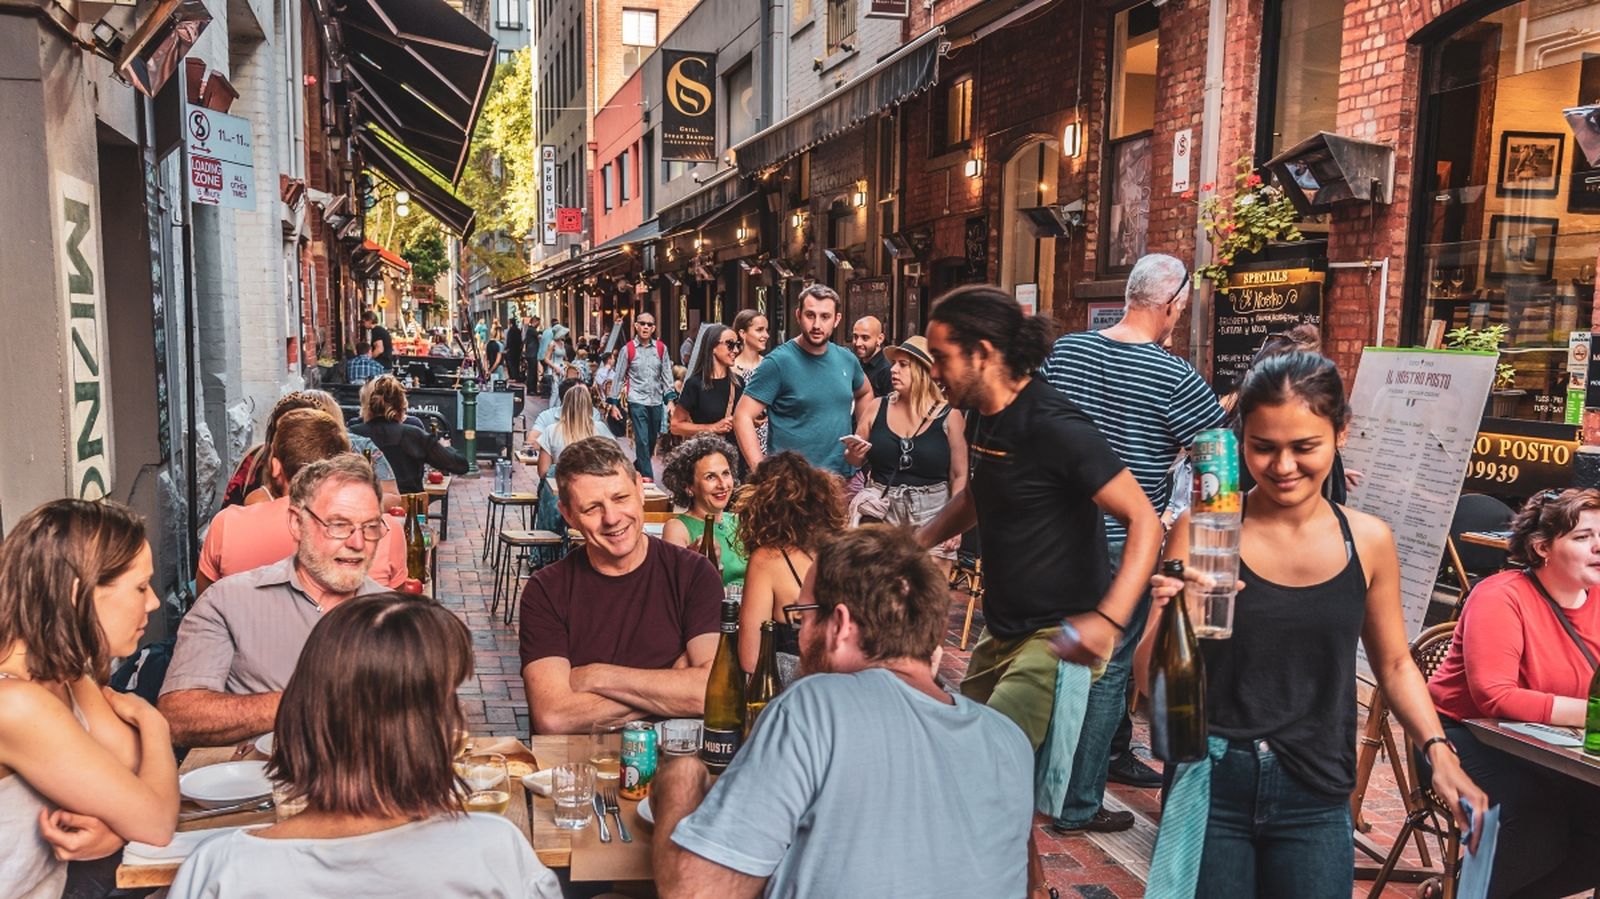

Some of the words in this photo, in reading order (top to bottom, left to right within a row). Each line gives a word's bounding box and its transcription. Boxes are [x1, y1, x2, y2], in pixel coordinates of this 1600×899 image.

[192, 159, 222, 176] LOADING
[194, 171, 221, 187] ZONE
[230, 182, 248, 191] OTHER
[233, 175, 243, 183] ALL
[232, 190, 248, 199] TIMES
[1243, 270, 1288, 285] SPECIALS
[1385, 369, 1394, 385] IL
[1395, 370, 1426, 385] NOSTRO
[1425, 372, 1452, 390] POSTO
[1498, 439, 1570, 466] POSTO
